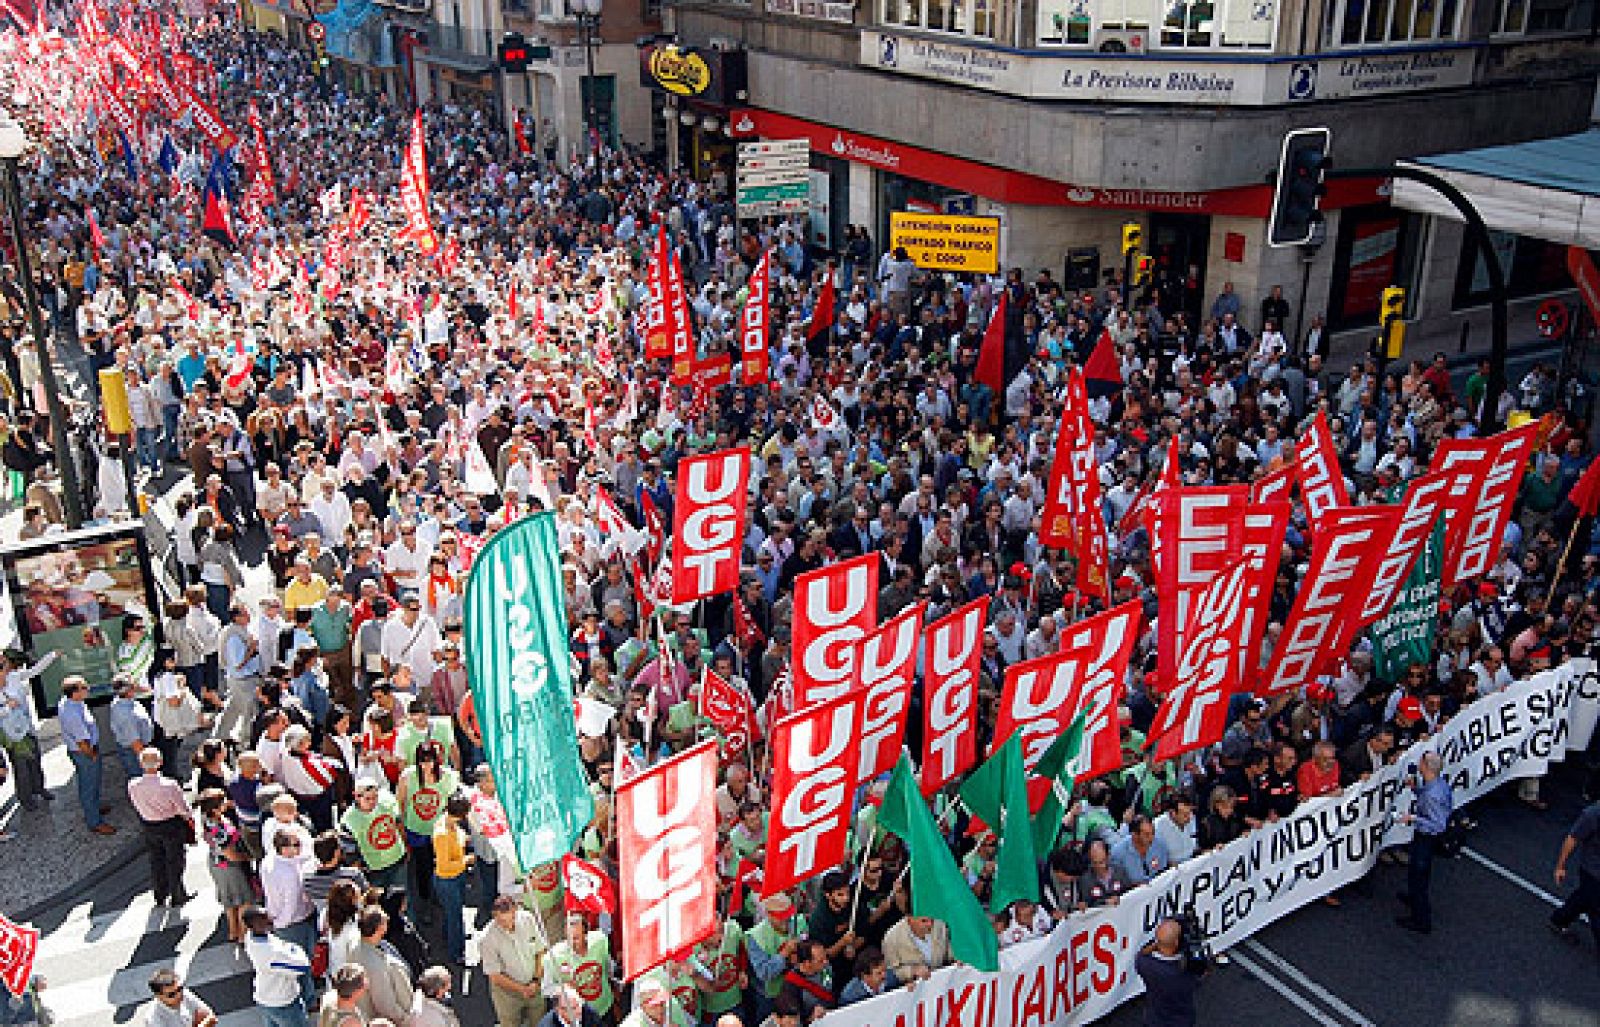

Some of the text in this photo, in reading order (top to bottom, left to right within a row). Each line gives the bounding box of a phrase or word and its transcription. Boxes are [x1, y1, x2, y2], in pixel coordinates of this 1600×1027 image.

[1062, 69, 1083, 88] La
[1088, 69, 1162, 88] Previsora
[846, 139, 900, 167] Santander
[1100, 189, 1208, 208] Santander
[682, 453, 743, 595] UGT
[1360, 478, 1448, 619] CCOO
[1268, 528, 1374, 691] CCOO
[857, 614, 918, 781] UGT
[929, 607, 982, 781] UGT
[632, 754, 704, 955] UGT
[779, 699, 856, 877] UGT
[1189, 840, 1263, 908] PLAN
[1263, 871, 1284, 902] Y
